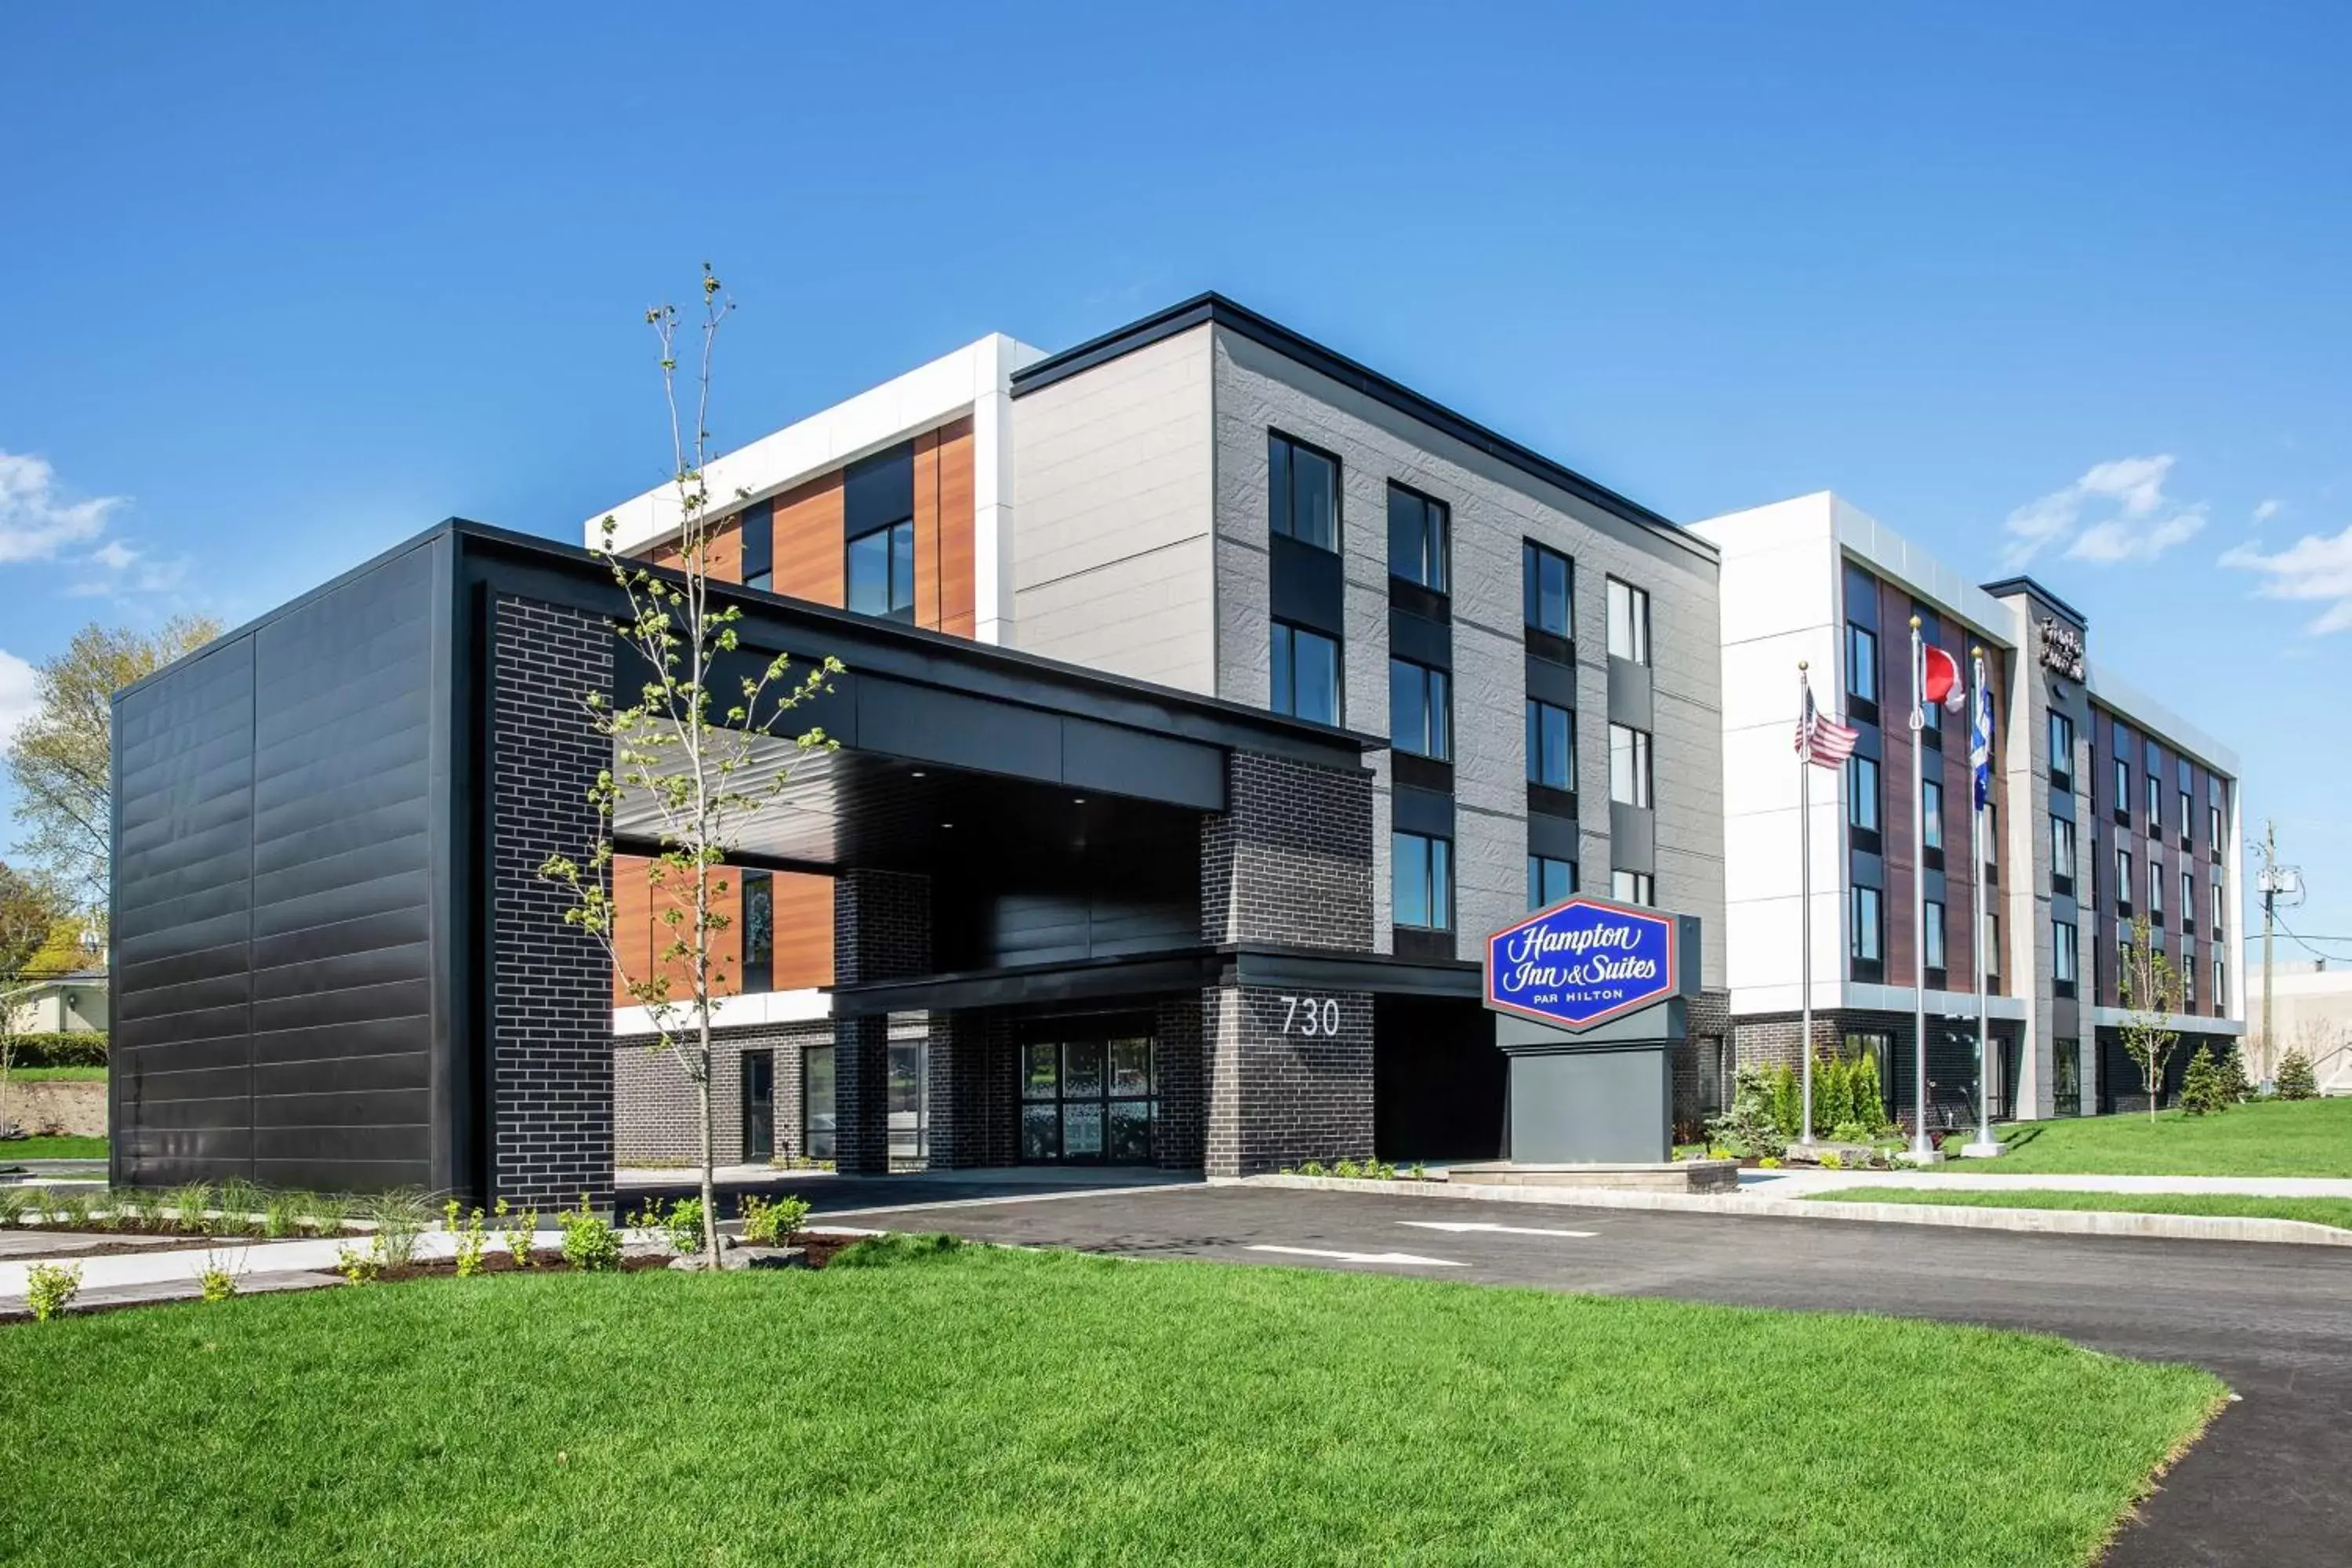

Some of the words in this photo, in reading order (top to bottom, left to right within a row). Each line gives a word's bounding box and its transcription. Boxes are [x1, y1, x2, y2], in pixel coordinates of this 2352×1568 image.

[1508, 923, 1642, 963] Hampton
[1503, 961, 1567, 992] Inn
[1568, 965, 1586, 985] &
[1584, 954, 1657, 983] Suites
[1280, 996, 1339, 1036] 730
[1534, 993, 1559, 1004] PAR
[1566, 989, 1623, 1002] HILTON
